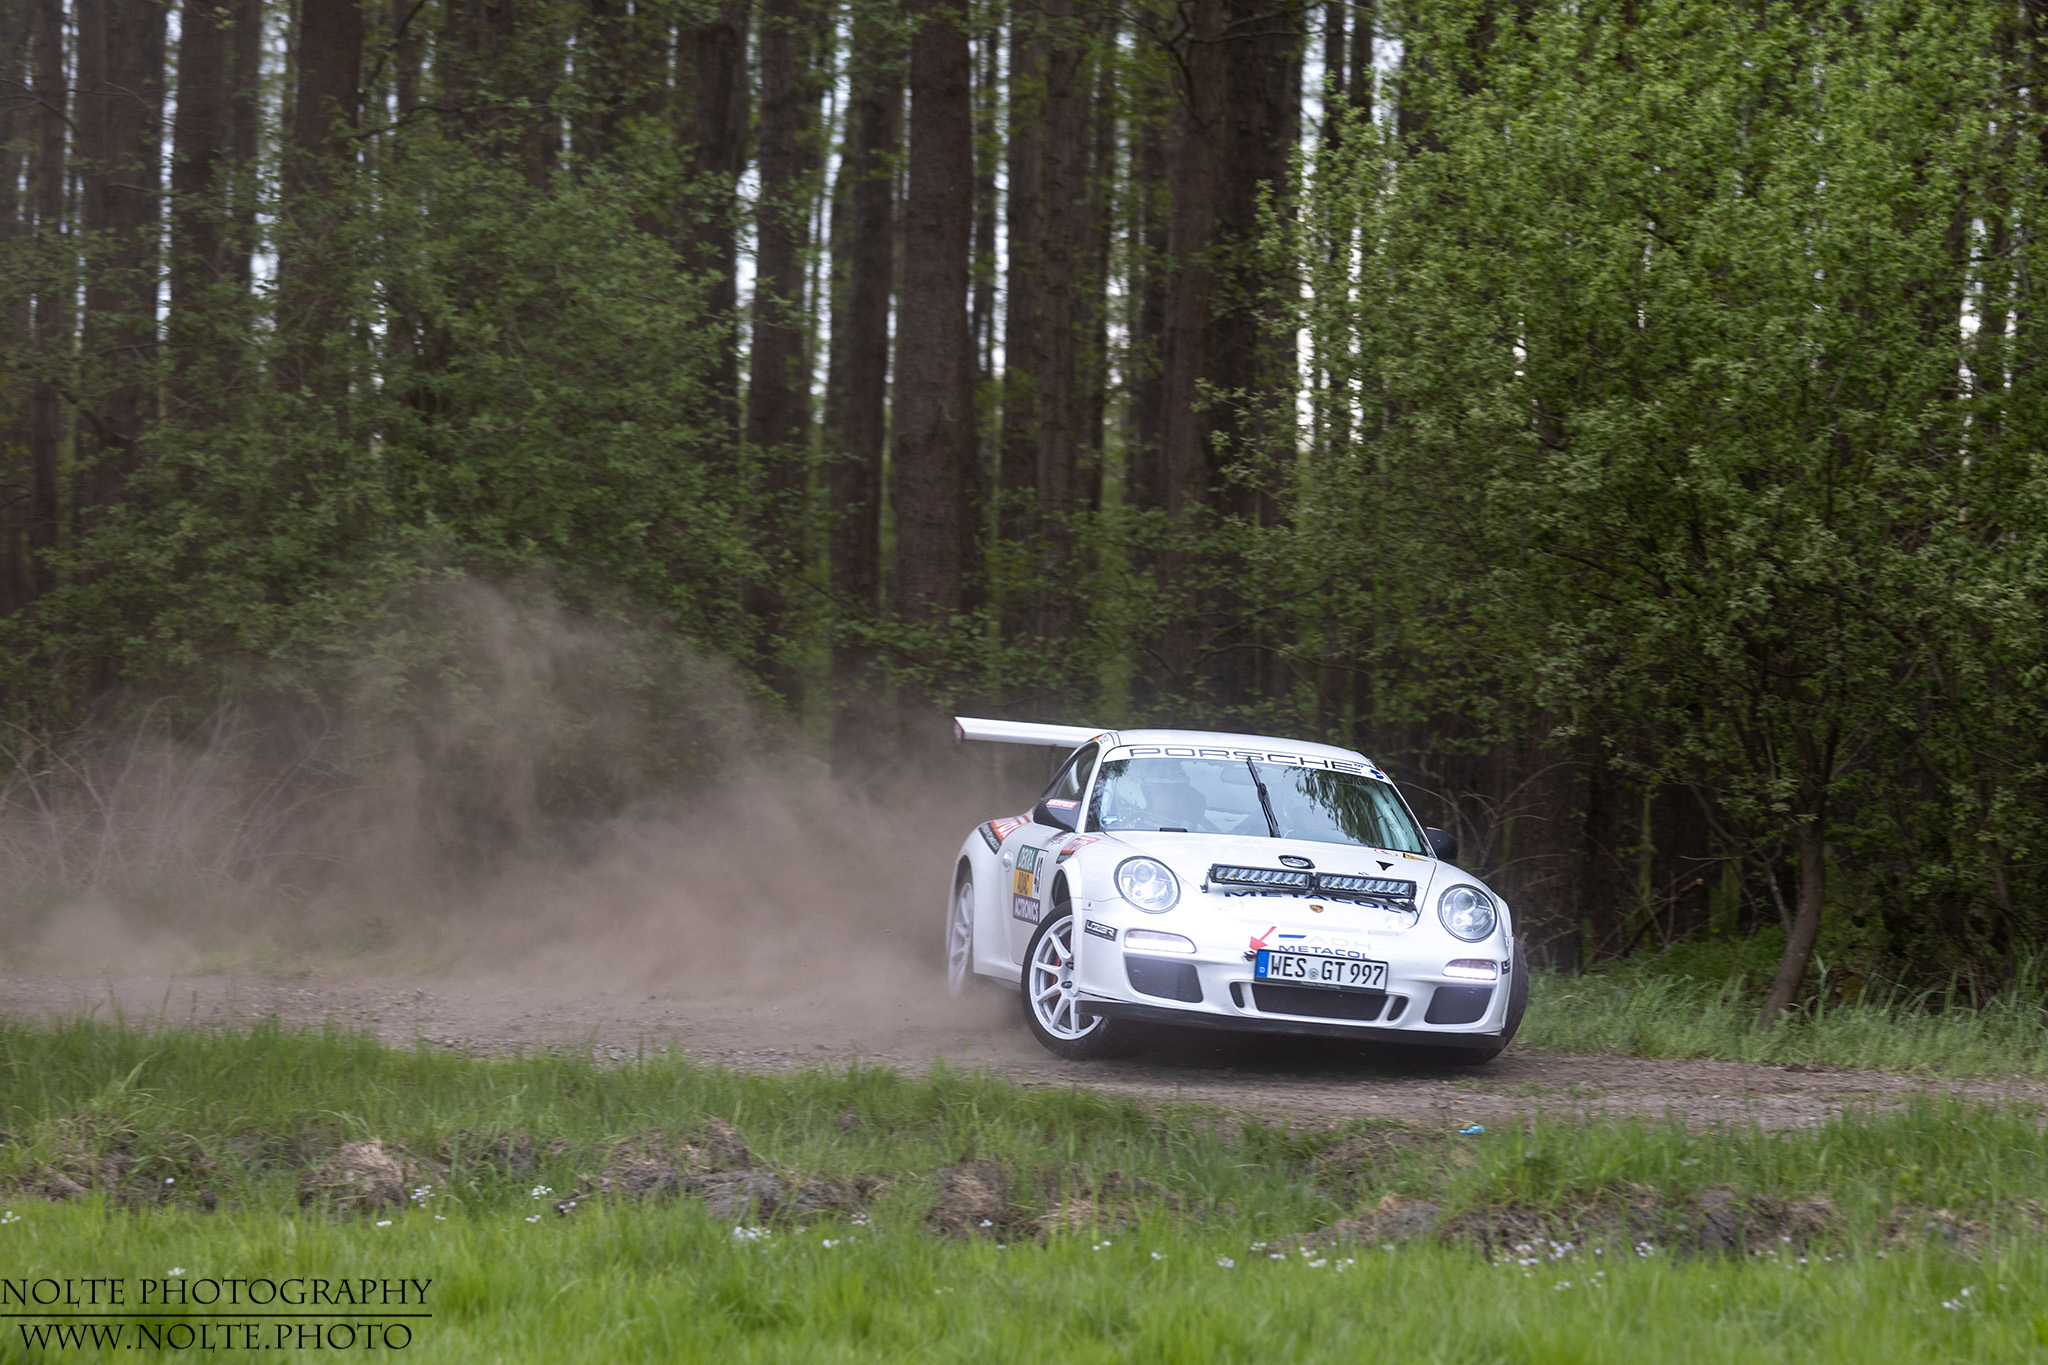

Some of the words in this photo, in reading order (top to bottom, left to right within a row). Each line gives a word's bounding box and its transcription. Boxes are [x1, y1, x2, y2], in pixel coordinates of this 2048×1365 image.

[1129, 747, 1362, 774] PORSCHE
[1018, 847, 1036, 872] DEKRA
[1017, 871, 1030, 896] ADAC
[1014, 897, 1039, 922] ACTRONICS
[1278, 944, 1372, 961] METACOL
[1270, 954, 1307, 978] WES
[1321, 960, 1346, 982] GT
[1350, 963, 1385, 986] 997
